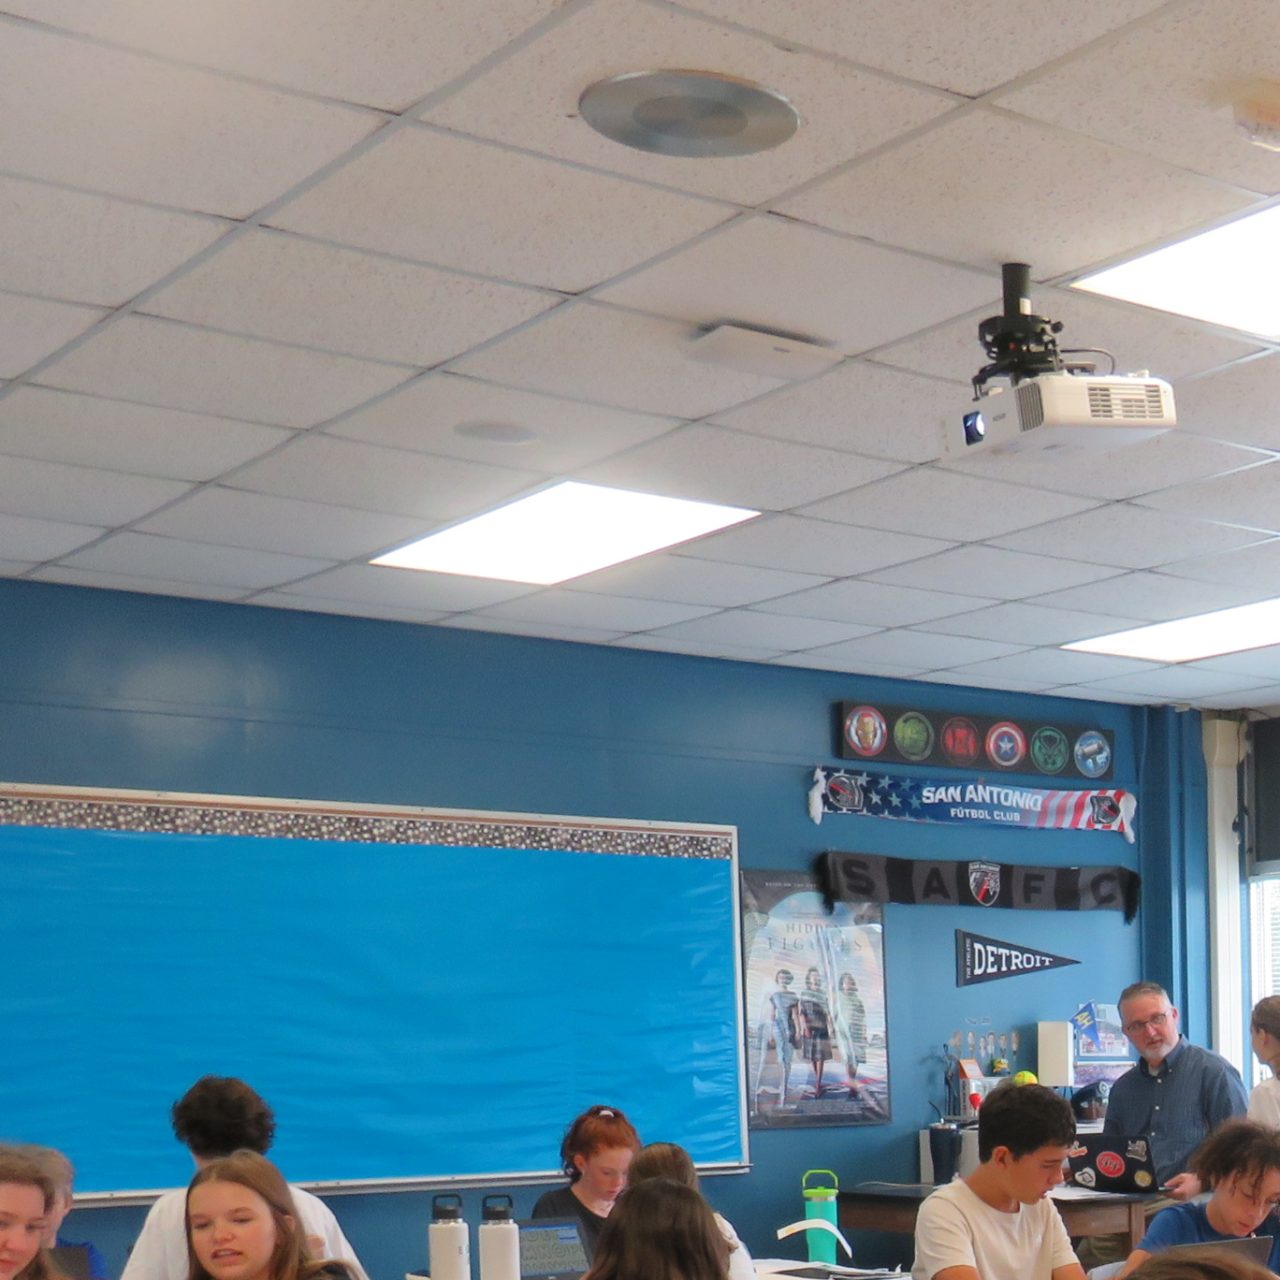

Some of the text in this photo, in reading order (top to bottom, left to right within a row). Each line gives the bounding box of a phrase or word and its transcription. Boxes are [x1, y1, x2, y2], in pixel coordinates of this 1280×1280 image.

[922, 784, 1043, 811] SAN ANTONIO
[993, 811, 1021, 821] CLUB
[973, 942, 1054, 975] DETROIT
